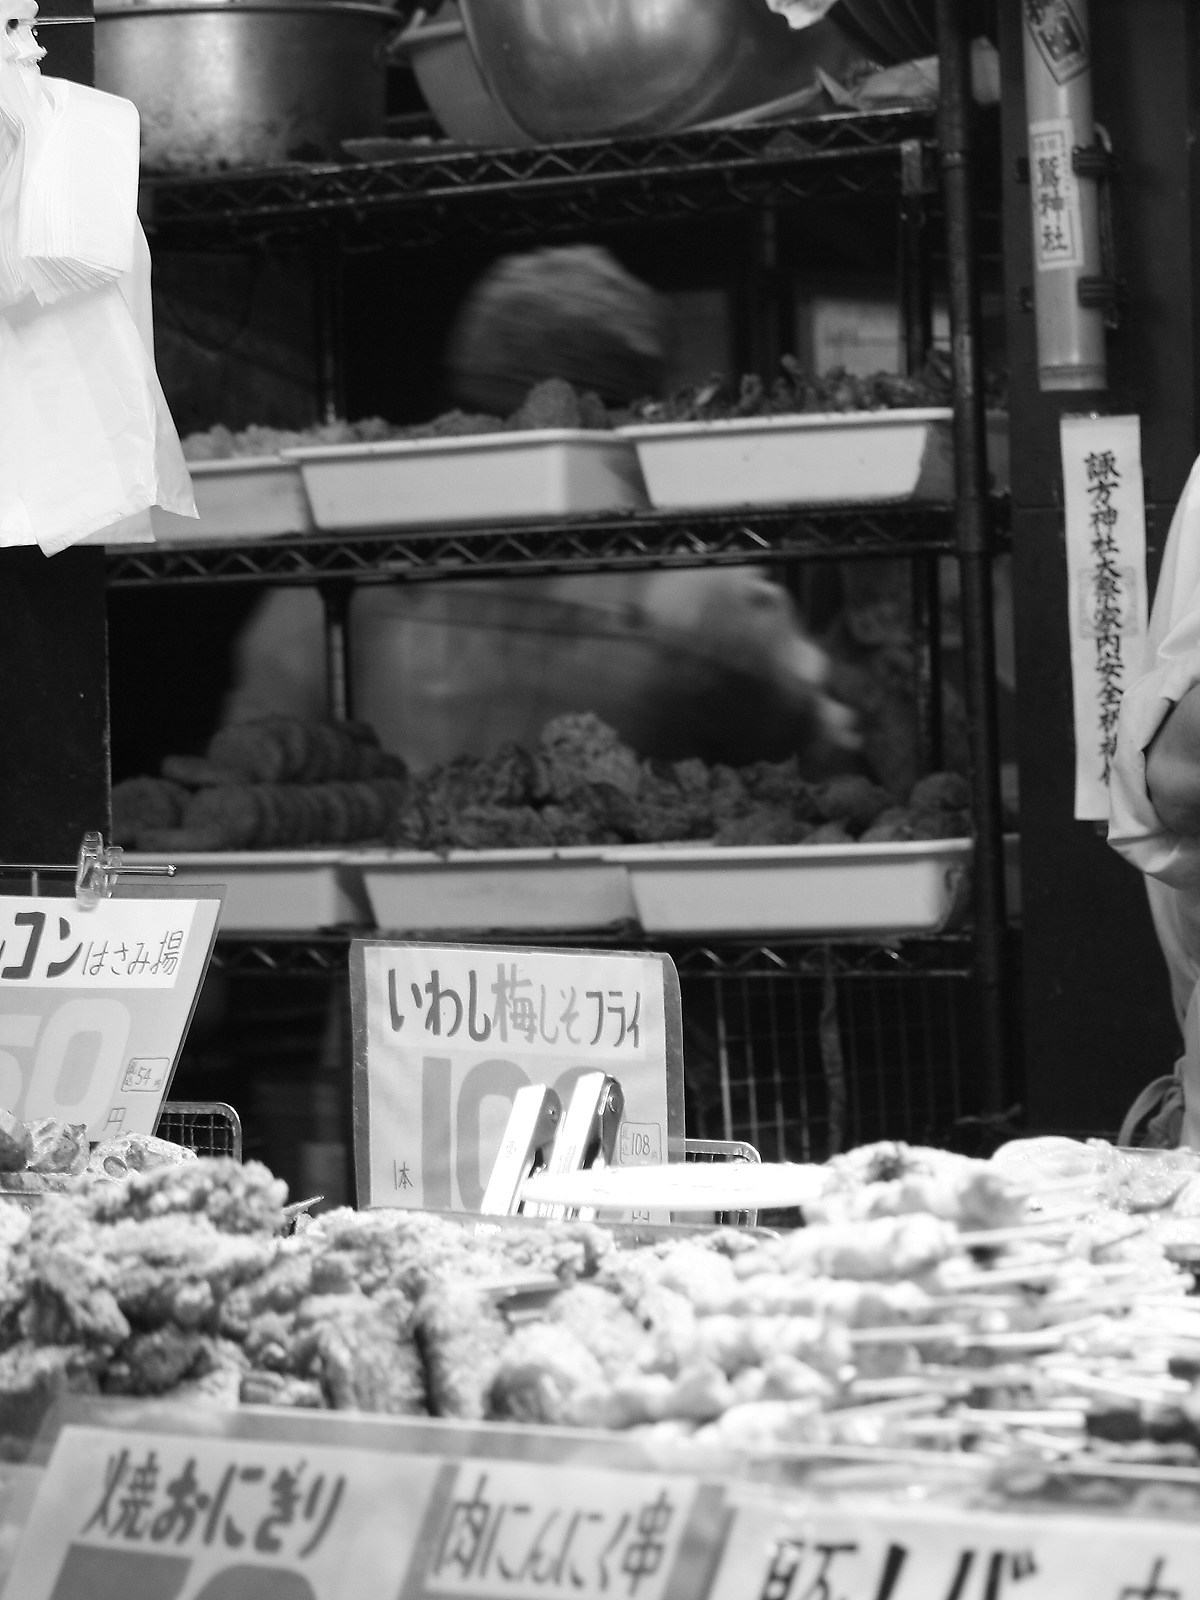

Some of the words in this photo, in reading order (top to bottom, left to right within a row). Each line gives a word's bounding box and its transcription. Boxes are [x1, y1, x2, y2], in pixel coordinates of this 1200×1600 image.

[0, 911, 184, 979] コンはさみ揚
[388, 963, 641, 1049] いわし梅しそフライ
[80, 1448, 347, 1560] 焼おにぎり
[431, 1472, 670, 1597] 肉にんにく串
